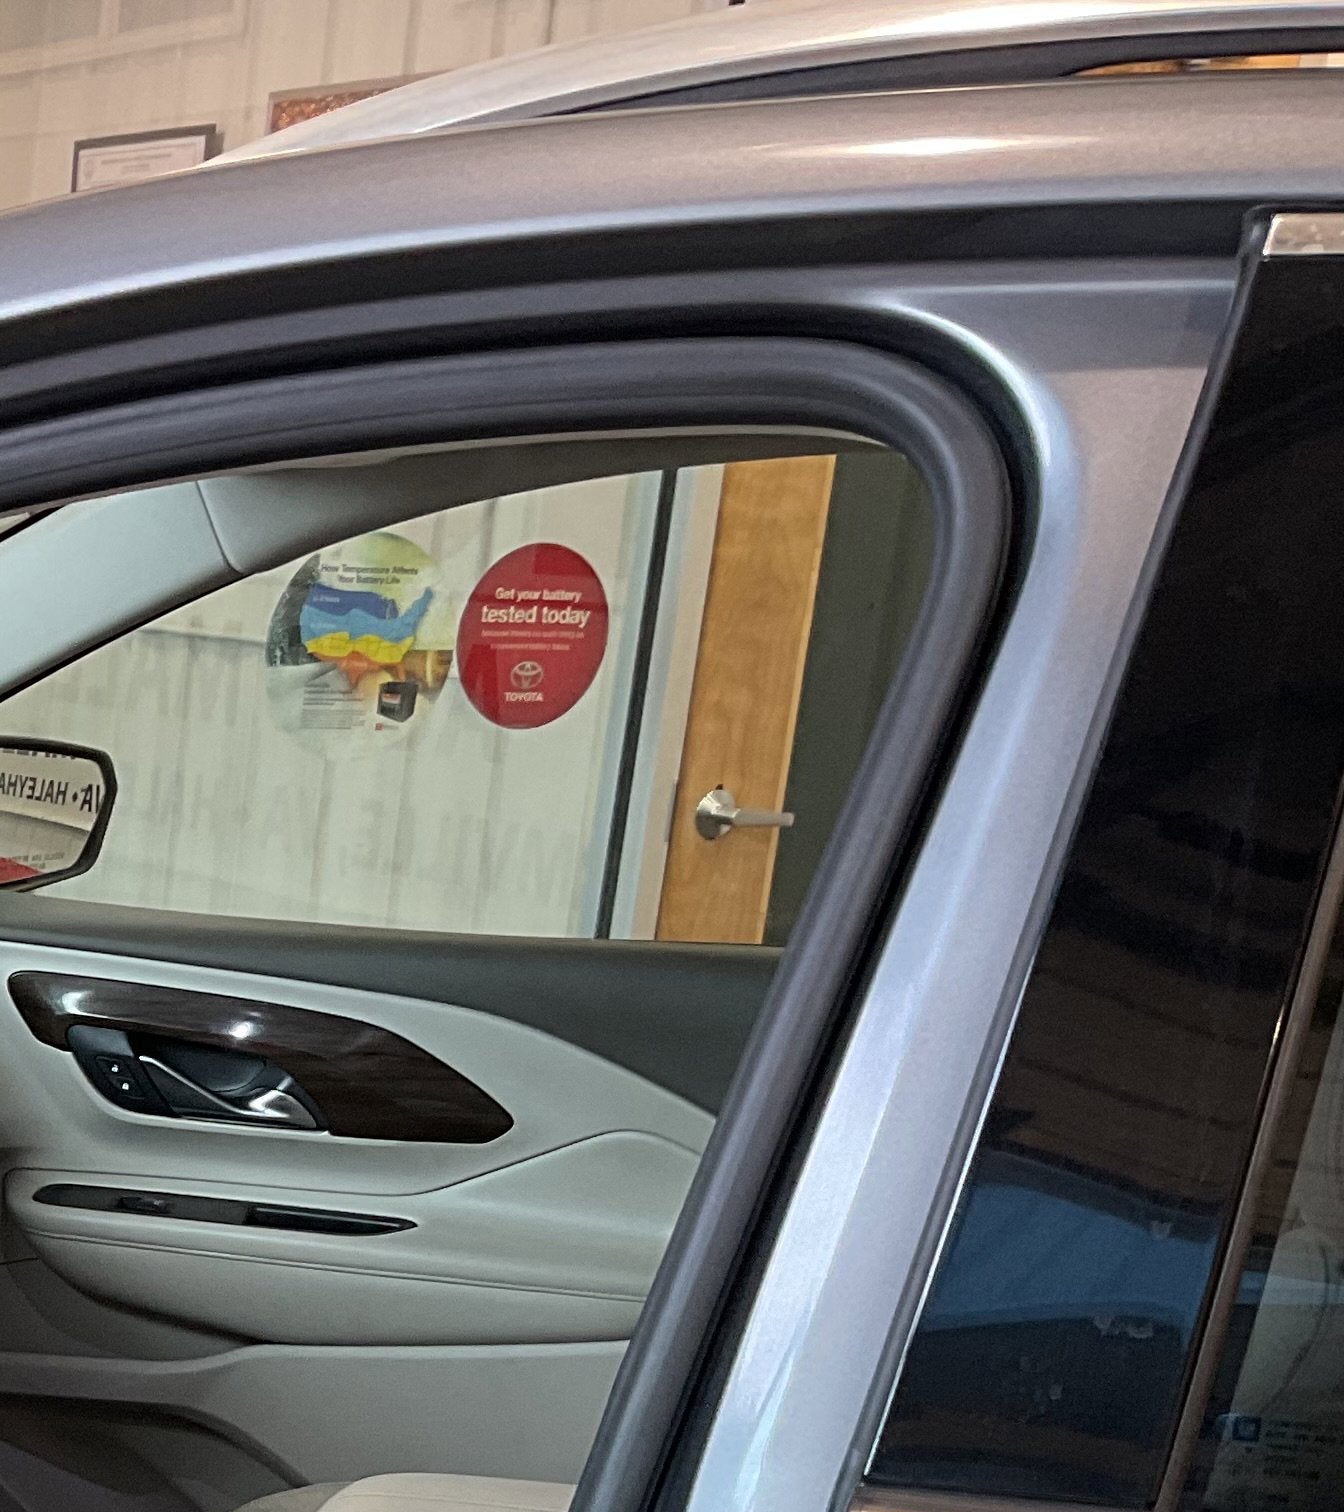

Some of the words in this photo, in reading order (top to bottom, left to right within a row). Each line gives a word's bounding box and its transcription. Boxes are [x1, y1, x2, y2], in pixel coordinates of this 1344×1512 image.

[495, 586, 516, 600] Get
[516, 589, 542, 603] your
[542, 588, 583, 604] battery
[481, 604, 538, 623] tested
[542, 606, 591, 629] today
[503, 691, 544, 703] TOYOTA
